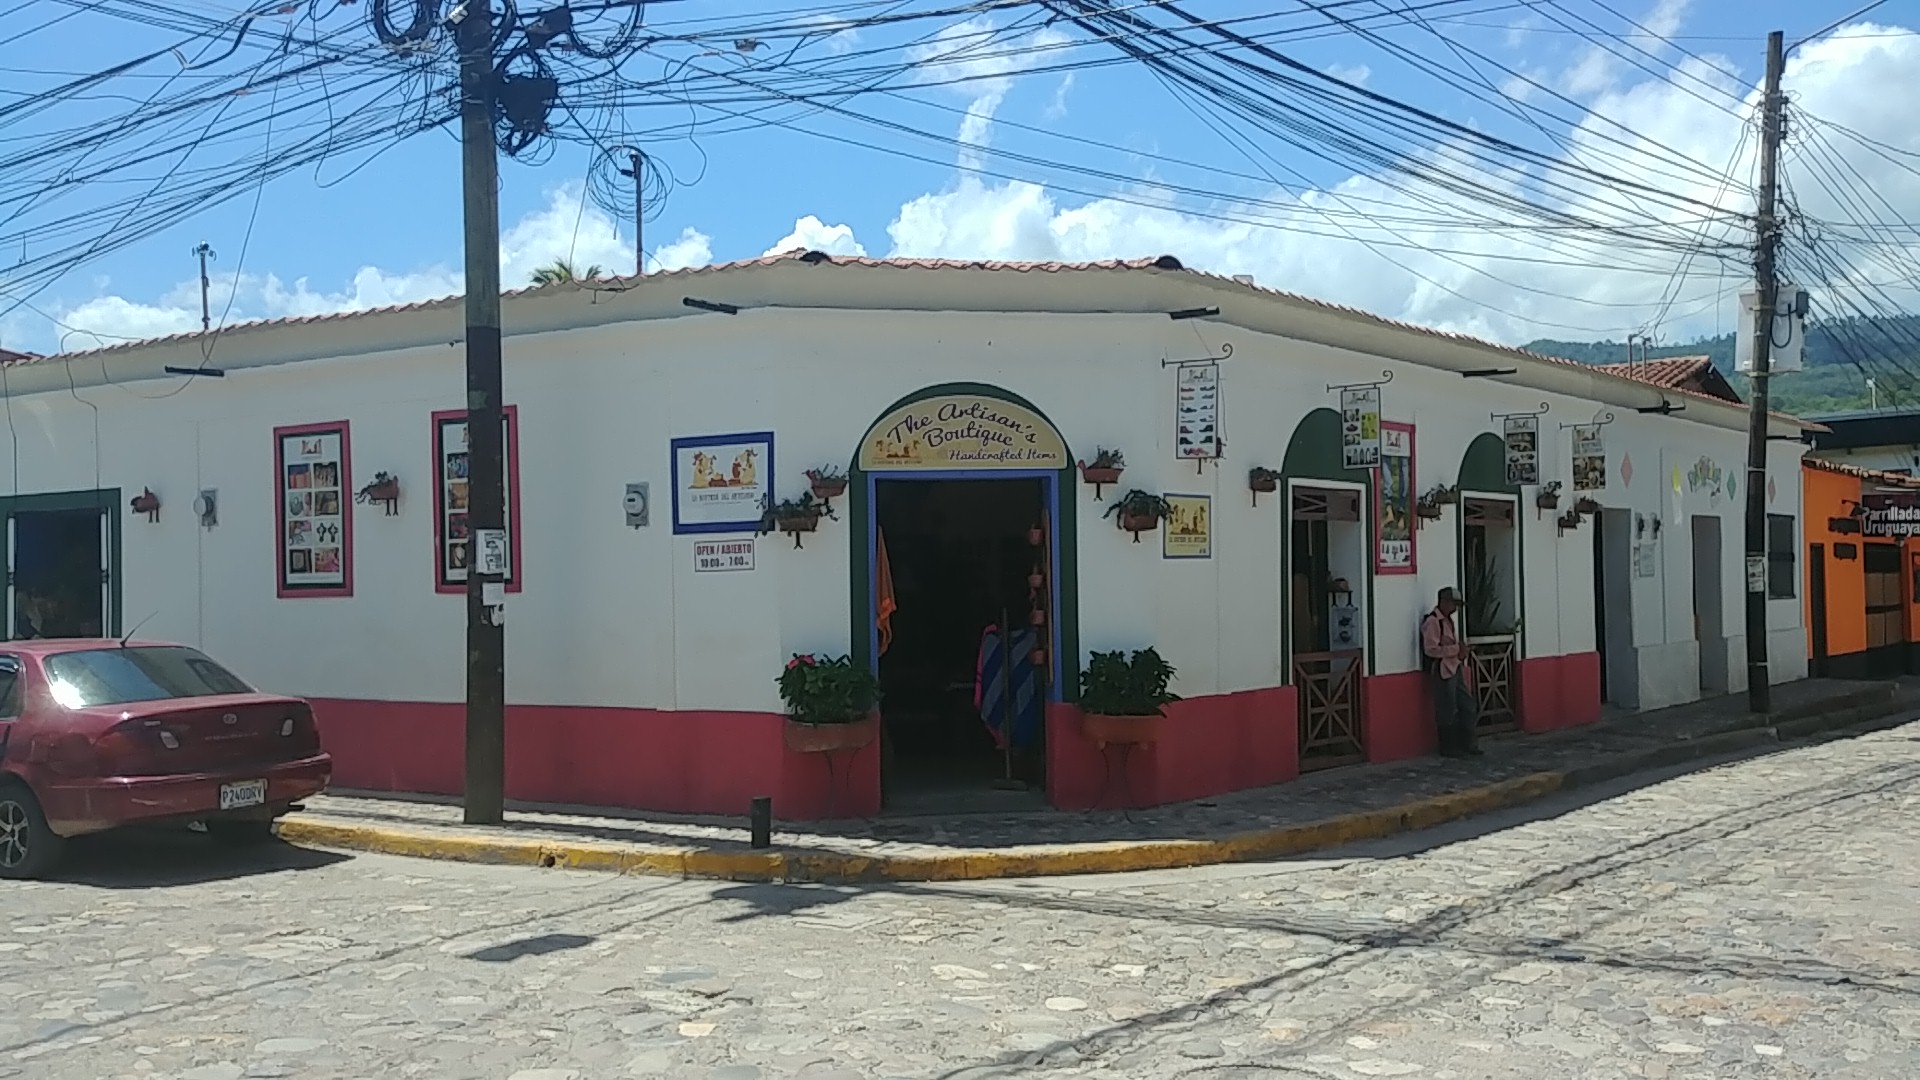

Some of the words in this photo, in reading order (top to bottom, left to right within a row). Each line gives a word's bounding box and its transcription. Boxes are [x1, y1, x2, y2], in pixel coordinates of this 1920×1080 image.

[886, 414, 933, 443] The
[938, 402, 1037, 443] Artisan's
[922, 421, 1013, 447] Boutique
[949, 449, 1023, 462] Handcrafted
[1026, 449, 1057, 460] Items
[696, 545, 715, 556] OPEN
[721, 543, 752, 555] ABIERTO
